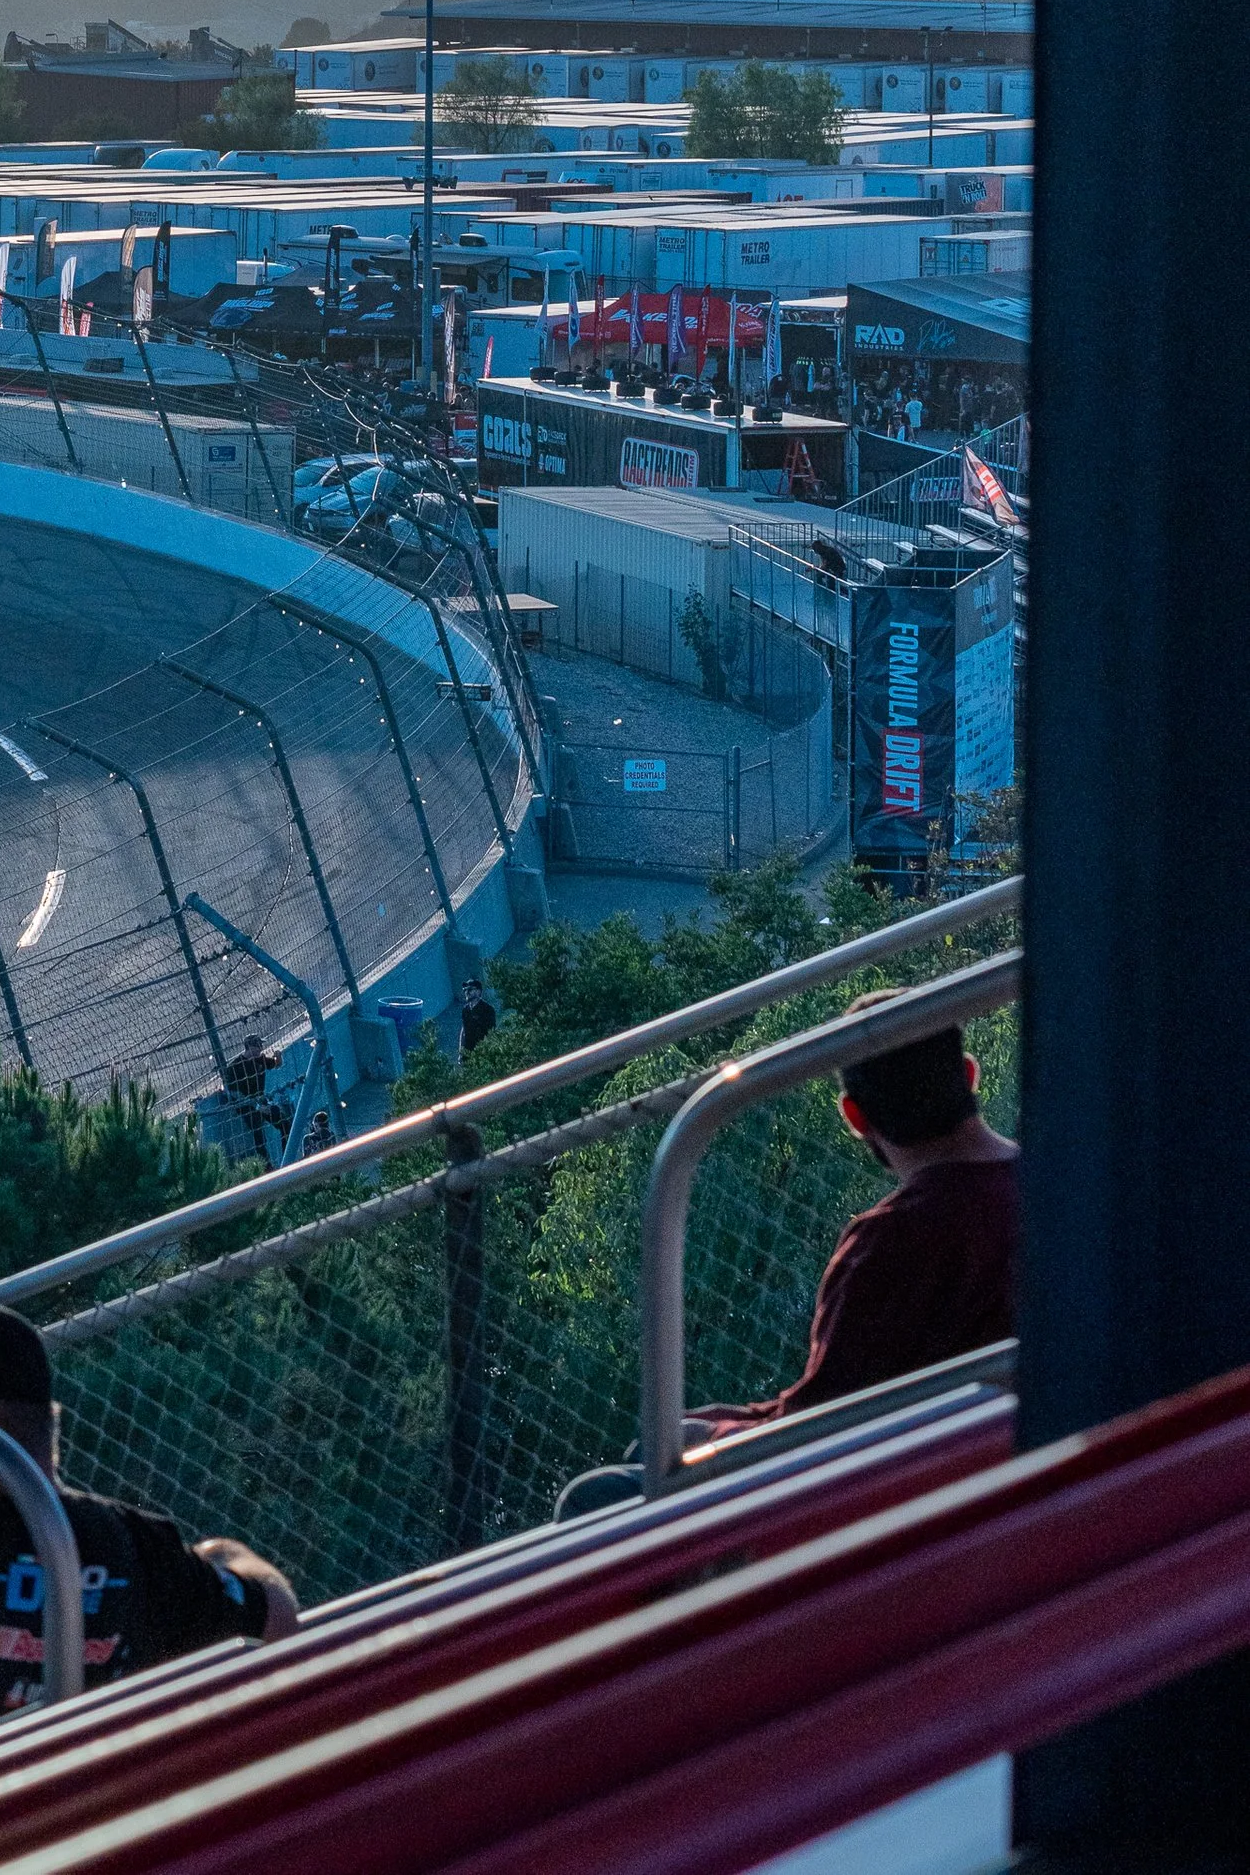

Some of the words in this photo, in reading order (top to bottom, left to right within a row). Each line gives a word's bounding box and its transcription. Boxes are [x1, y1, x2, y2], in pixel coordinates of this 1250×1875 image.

[960, 181, 986, 194] TRUCK
[659, 236, 685, 244] METRO
[741, 241, 770, 254] METRO
[741, 252, 770, 266] TRAILER
[855, 323, 905, 345] RAD
[544, 453, 566, 475] OPTIMA
[622, 439, 690, 488] RACETREADS
[888, 621, 919, 727] FORMULA
[634, 762, 655, 770] PHOTO
[625, 771, 665, 779] CREDENTIALS
[885, 734, 920, 812] DRIFT
[631, 781, 659, 789] REQUIRED
